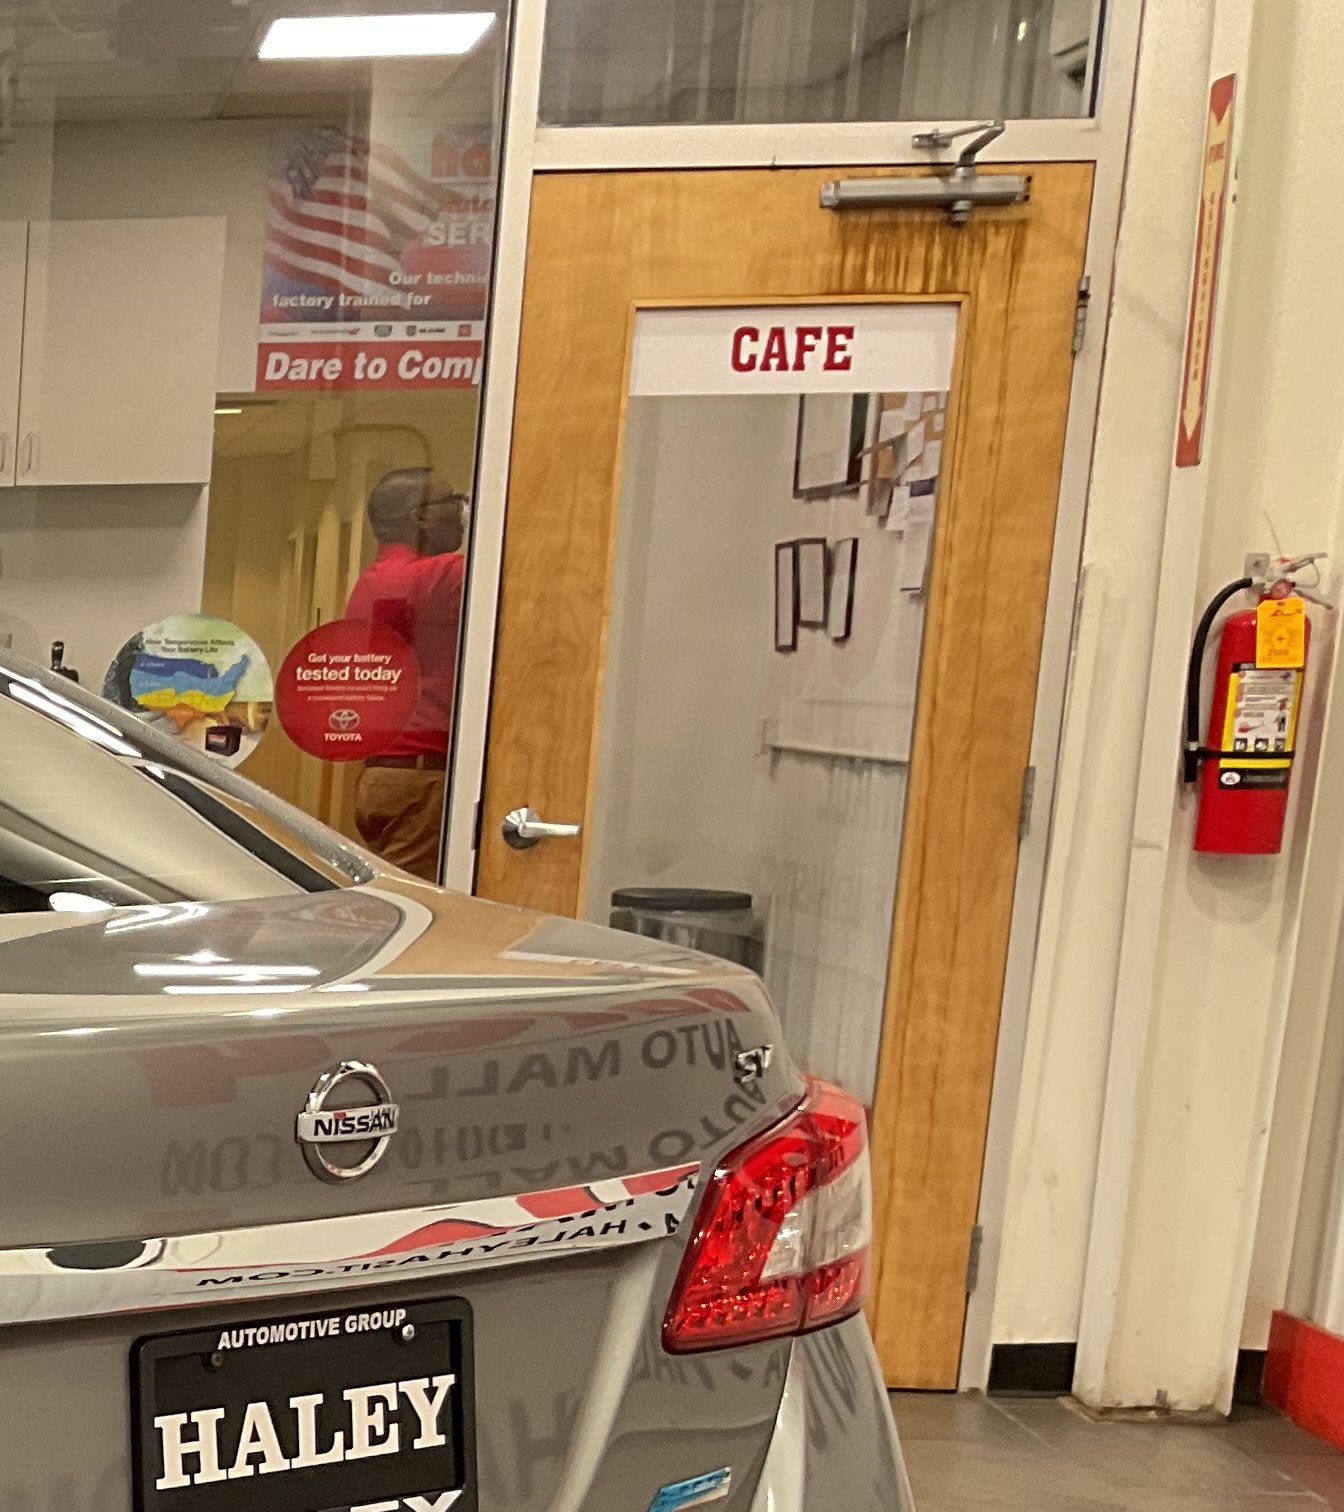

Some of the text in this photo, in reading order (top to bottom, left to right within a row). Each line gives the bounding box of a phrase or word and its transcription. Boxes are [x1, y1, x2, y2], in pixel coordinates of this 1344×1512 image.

[389, 271, 420, 286] Our
[272, 292, 432, 310] factory trained for
[731, 326, 855, 372] CAFE
[265, 352, 342, 381] Dare
[354, 351, 388, 381] to
[308, 653, 392, 665] Get your battery
[296, 666, 402, 683] tested today
[324, 732, 362, 741] TOYOTA
[314, 1106, 395, 1137] NISSAN
[218, 1307, 407, 1350] AUTOMOTIVE GROUP
[154, 1373, 456, 1490] HALEY
